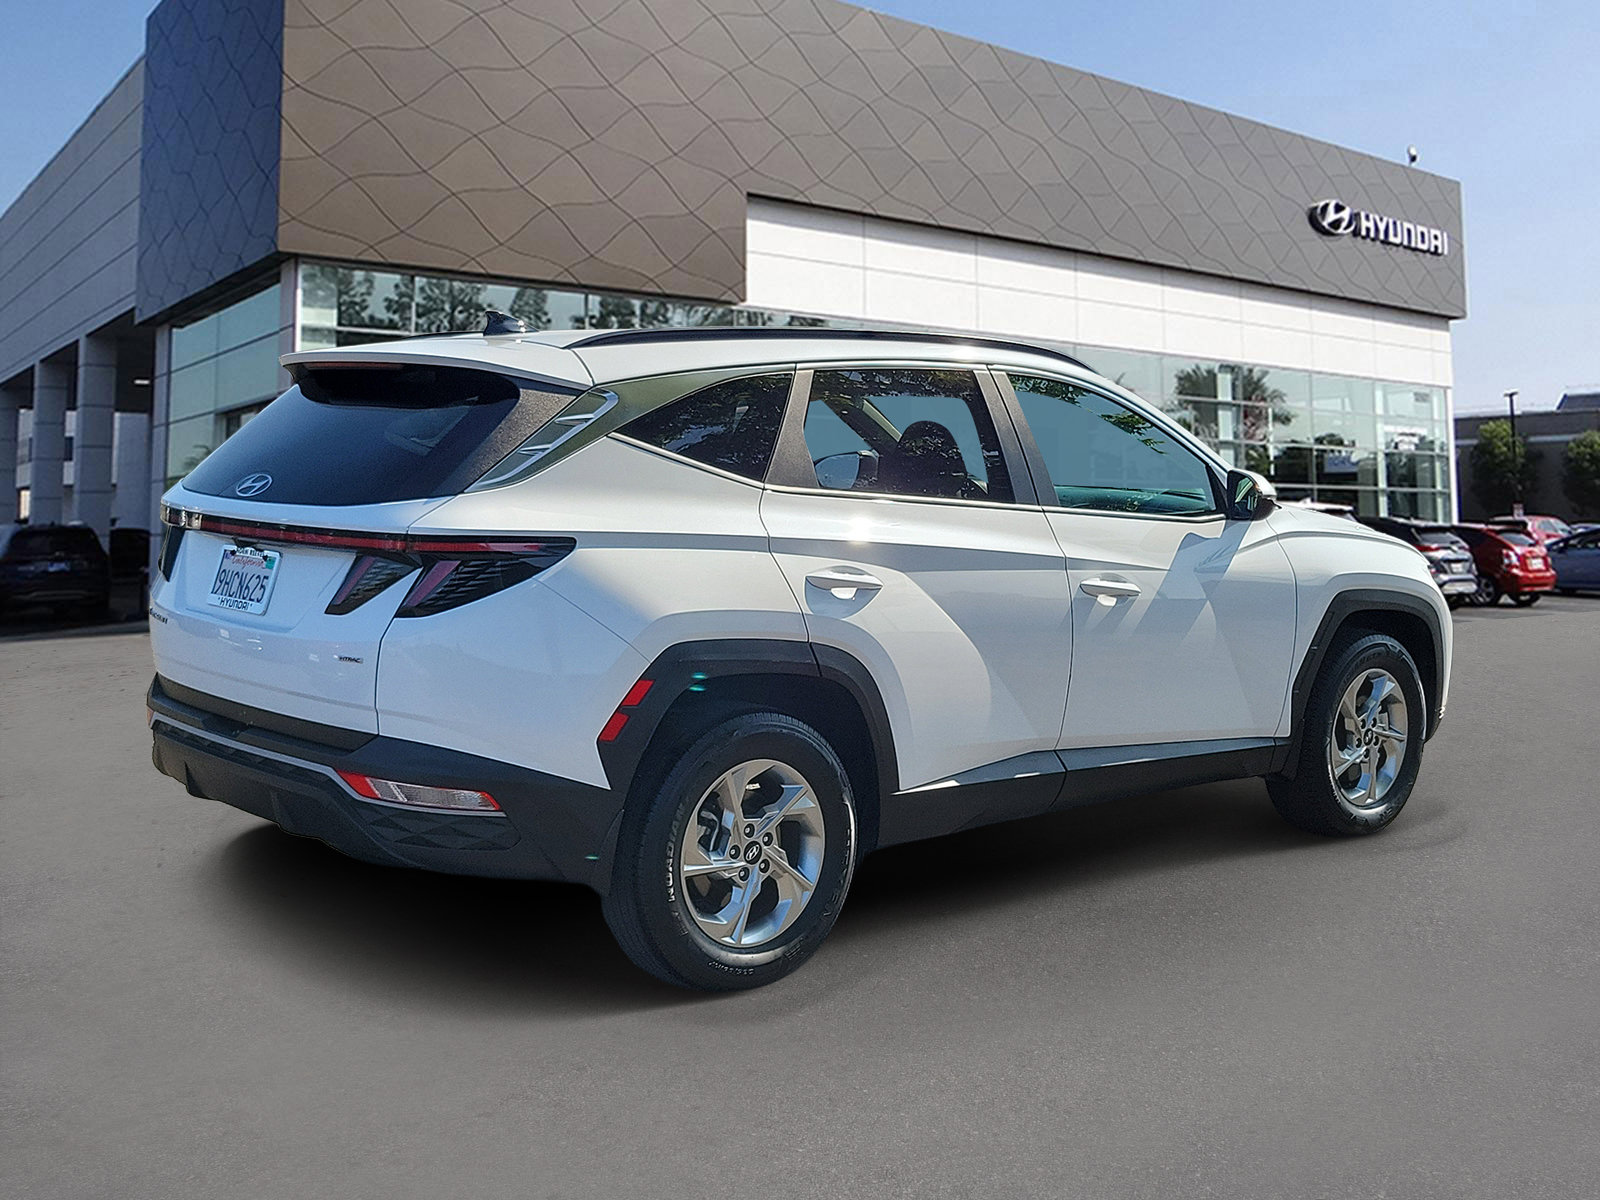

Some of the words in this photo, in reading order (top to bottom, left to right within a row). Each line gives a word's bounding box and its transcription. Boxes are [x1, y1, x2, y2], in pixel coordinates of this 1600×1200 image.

[1360, 211, 1448, 255] HYUNDAI
[214, 568, 269, 603] 9HCN625
[220, 597, 250, 610] HYUNDAI
